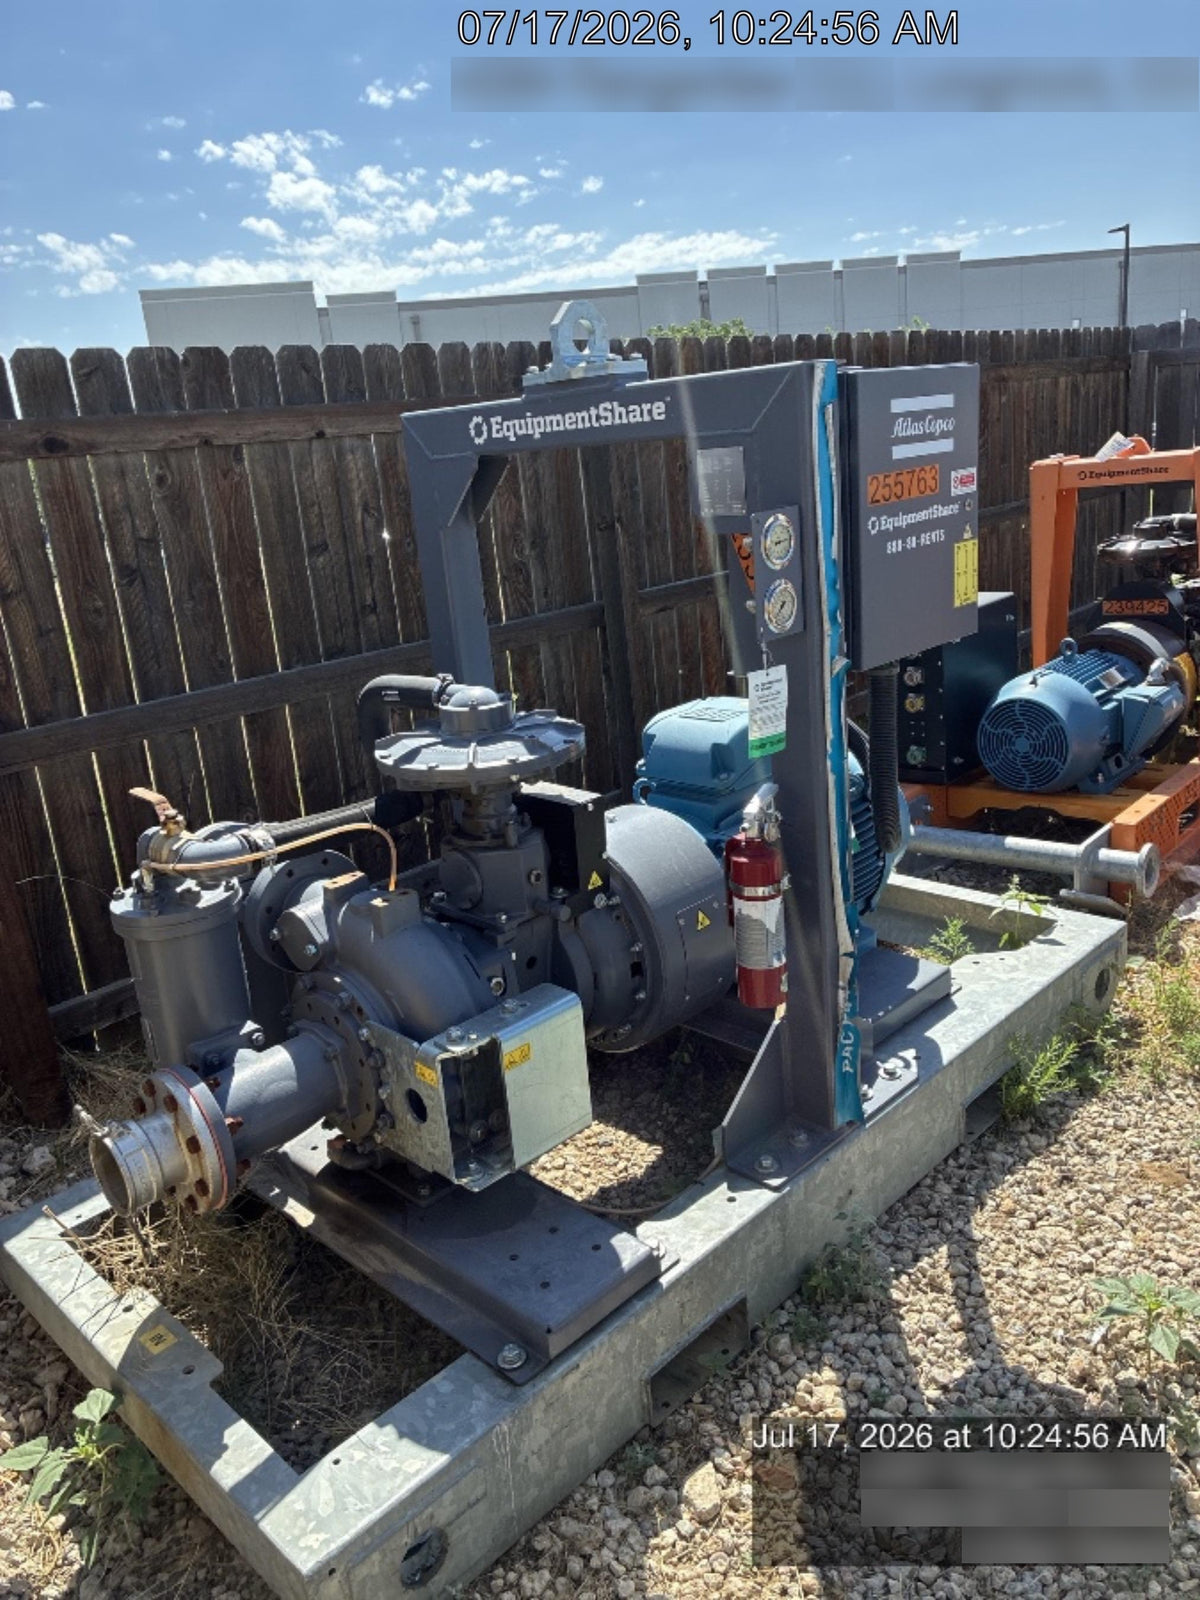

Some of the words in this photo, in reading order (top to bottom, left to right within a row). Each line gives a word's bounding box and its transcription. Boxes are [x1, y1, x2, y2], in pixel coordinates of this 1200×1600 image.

[491, 400, 666, 442] EquipmentShare
[890, 417, 924, 438] Atlas
[924, 415, 955, 436] Copco
[869, 465, 938, 504] 255763
[880, 503, 959, 532] EquipmentShare
